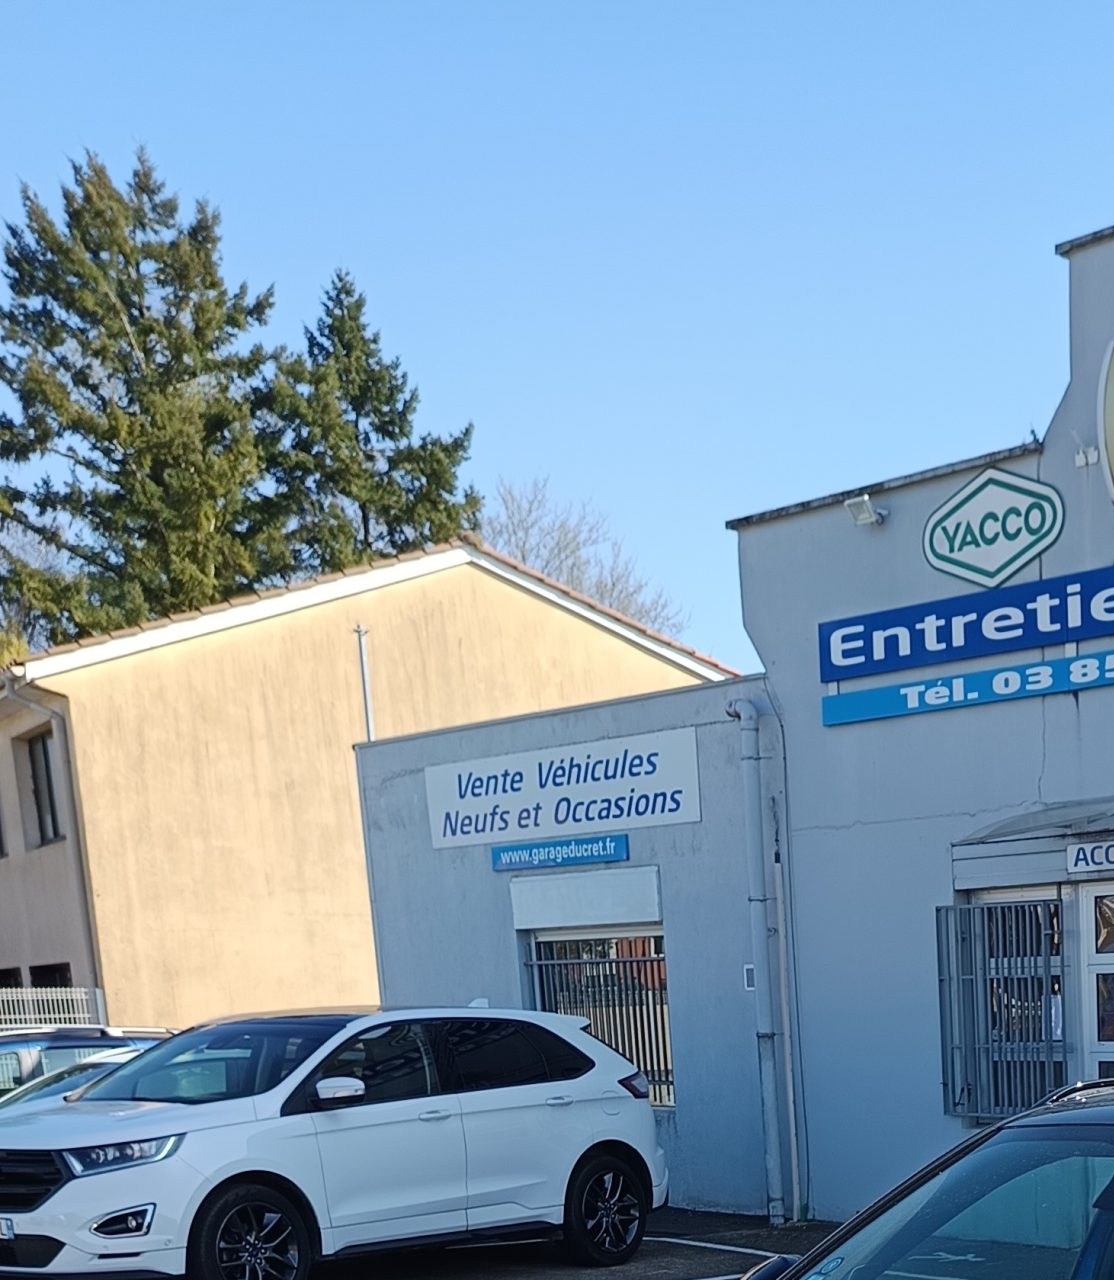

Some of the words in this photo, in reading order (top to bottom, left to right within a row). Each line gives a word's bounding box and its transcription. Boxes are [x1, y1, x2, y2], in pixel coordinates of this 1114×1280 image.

[941, 505, 1047, 554] YACCO
[900, 678, 979, 709] Tél.
[992, 665, 1054, 696] 03
[457, 768, 524, 800] Vente
[537, 749, 660, 790] Véhicules
[442, 804, 511, 838] Neufs
[517, 802, 543, 829] et
[553, 788, 683, 825] Occasions
[500, 838, 616, 864] www.garageducret.fr
